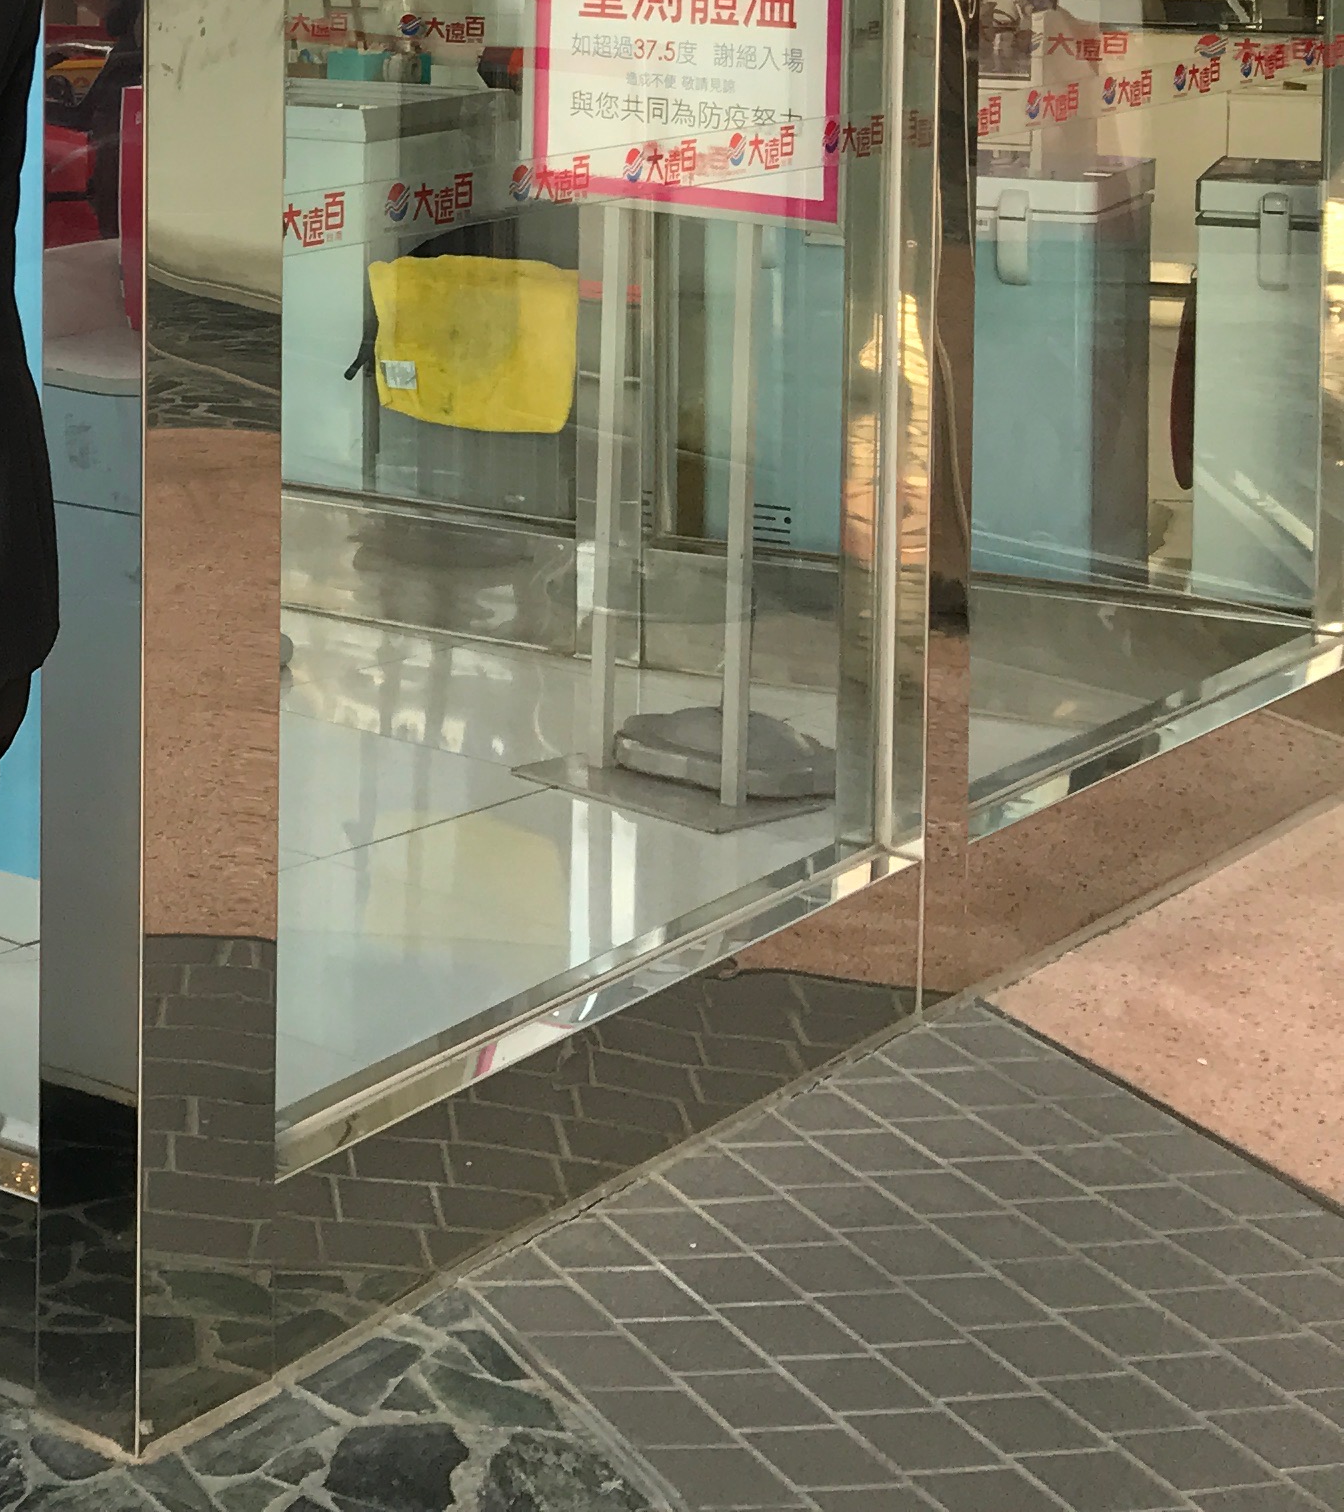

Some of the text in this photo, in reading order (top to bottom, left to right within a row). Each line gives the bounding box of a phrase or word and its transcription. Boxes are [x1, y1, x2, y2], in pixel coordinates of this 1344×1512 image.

[290, 12, 348, 38] 大遠百
[424, 16, 486, 44] 大遠百
[571, 33, 805, 74] 如超過37.5度 謝絕入場
[1046, 31, 1129, 62] 大遠百
[1117, 69, 1153, 107] 大遠百
[1188, 56, 1221, 93] 大遠百
[1042, 82, 1079, 122] 大遠百
[747, 124, 796, 171] 大遠百
[841, 114, 885, 158] 大遠百
[535, 154, 591, 204] 大遠百
[646, 138, 698, 186] 大遠百
[412, 172, 474, 225] 大遠百
[283, 191, 346, 248] 大遠百
